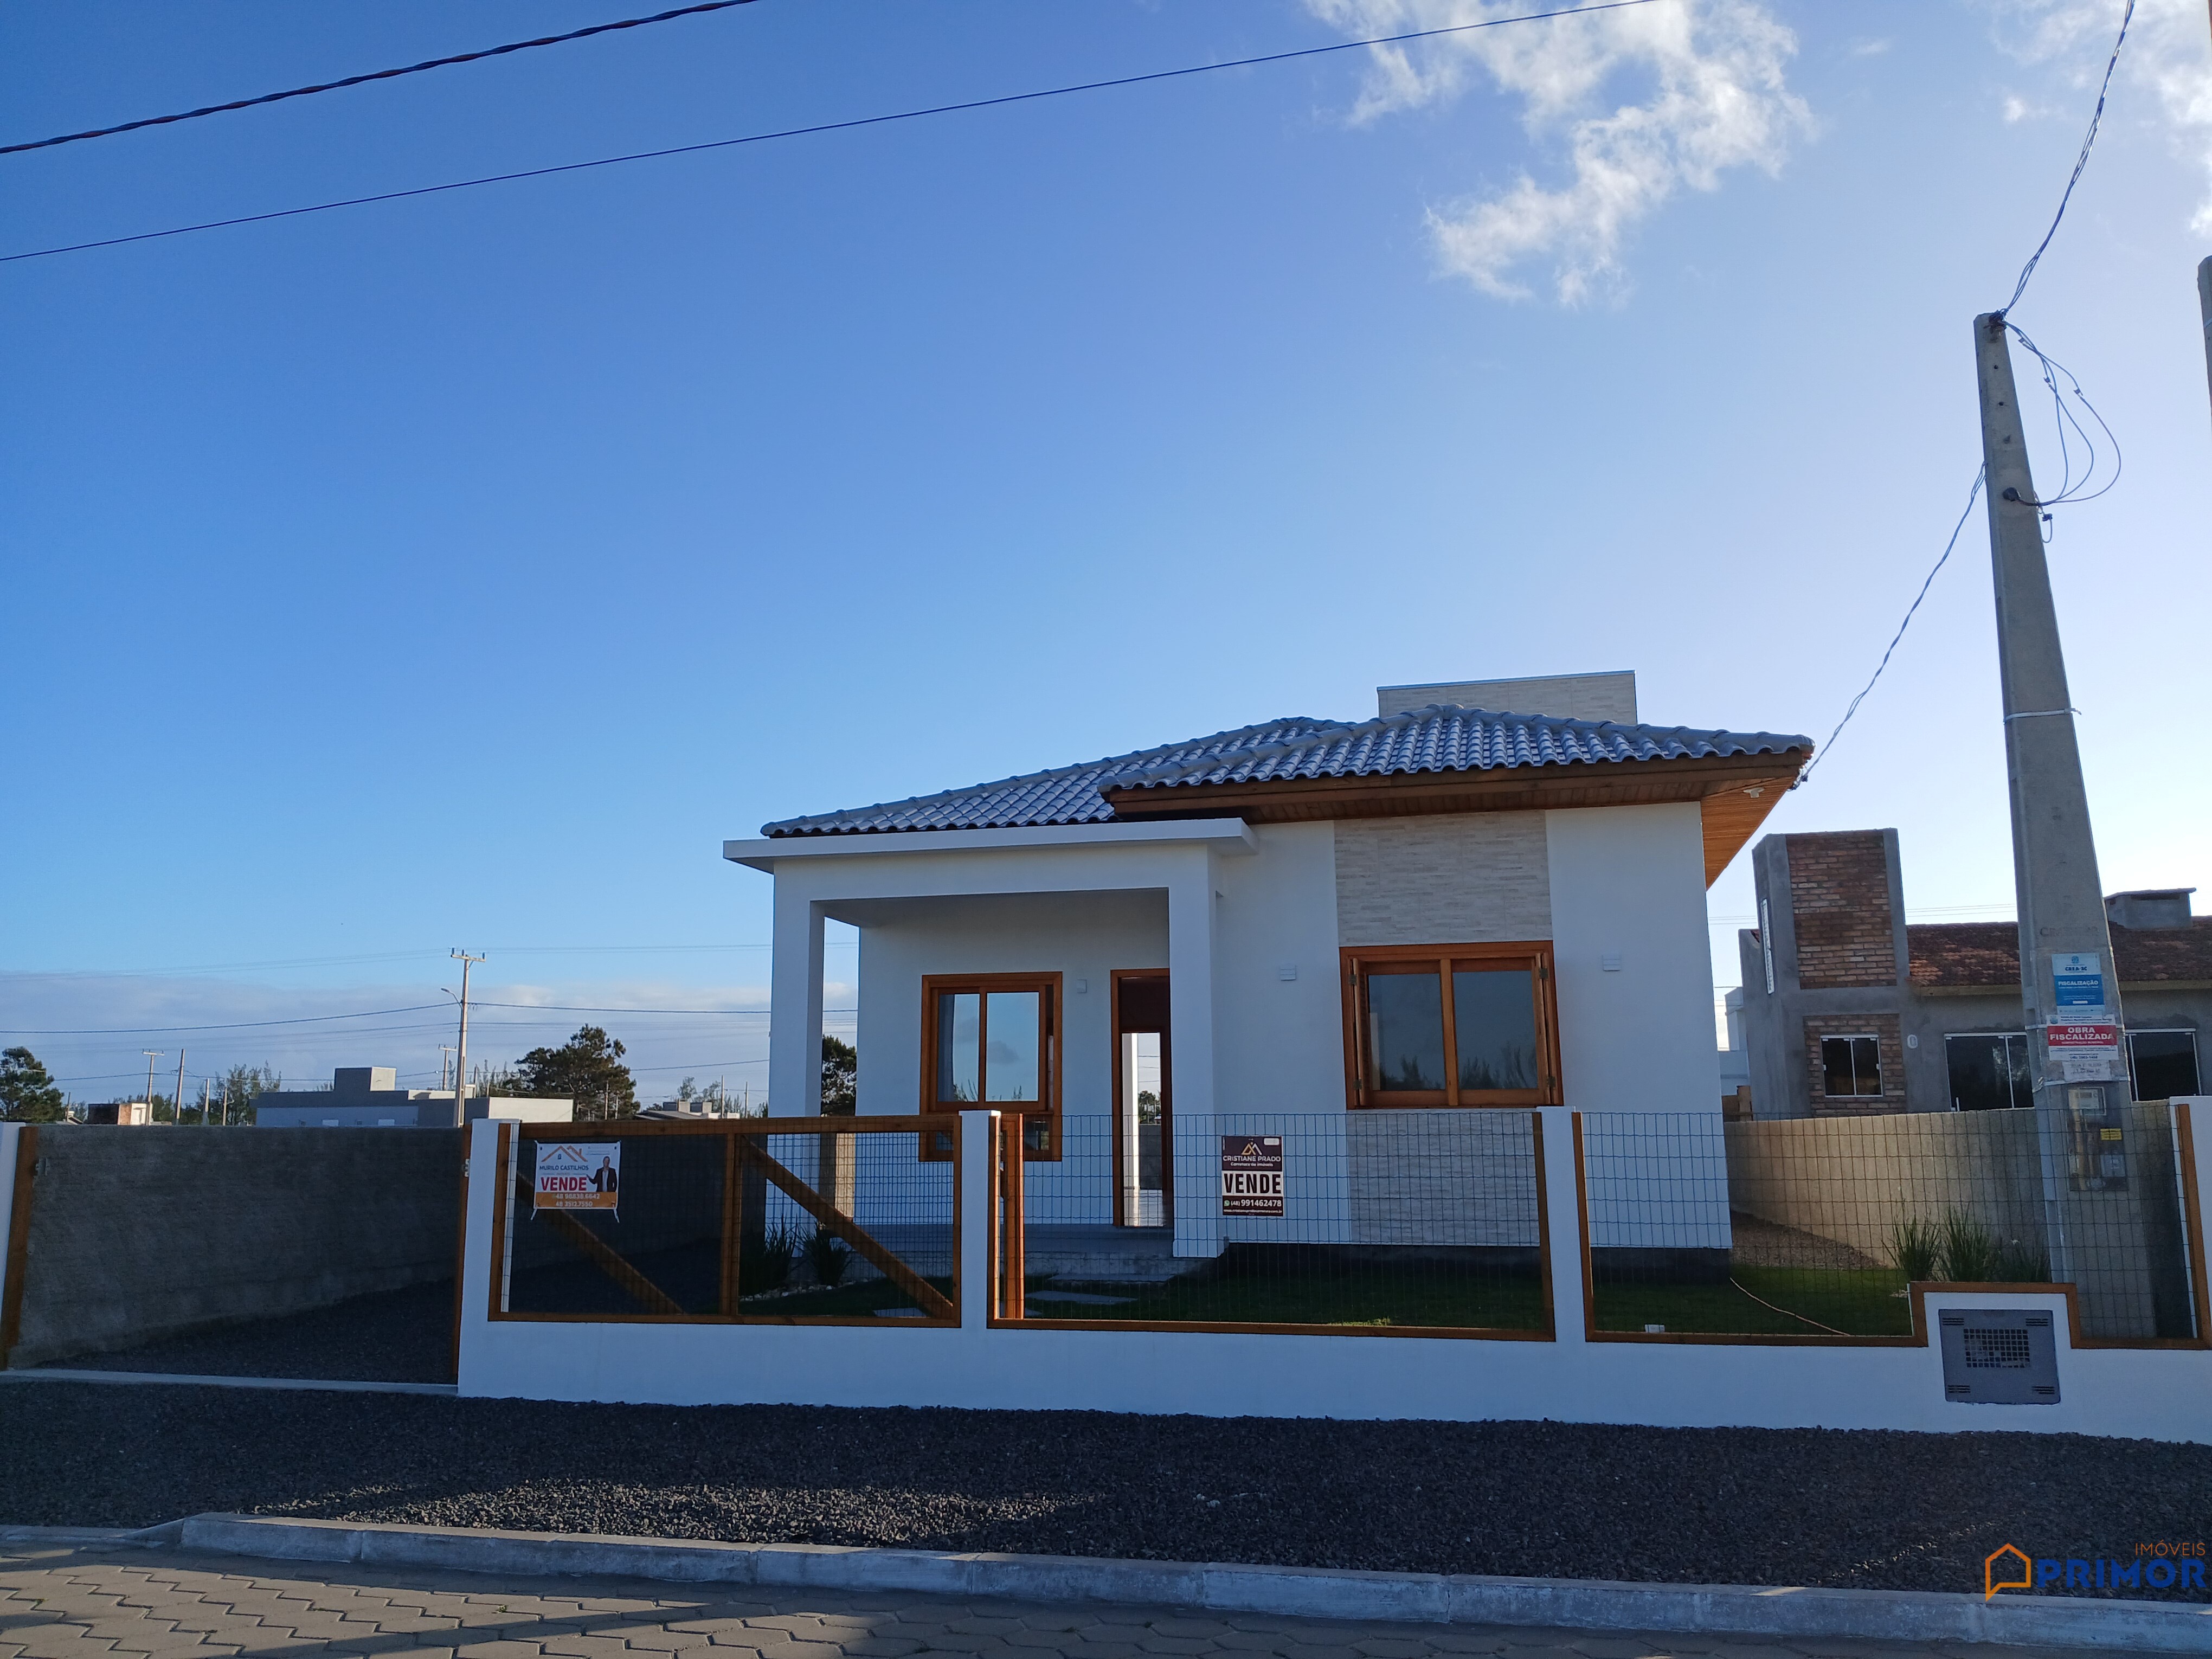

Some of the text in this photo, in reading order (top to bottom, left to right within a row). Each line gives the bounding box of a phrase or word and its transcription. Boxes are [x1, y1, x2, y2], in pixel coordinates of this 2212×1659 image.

[541, 1176, 587, 1191] VENDE
[1224, 1173, 1282, 1194] VENDE
[1241, 1199, 1282, 1207] 991462478
